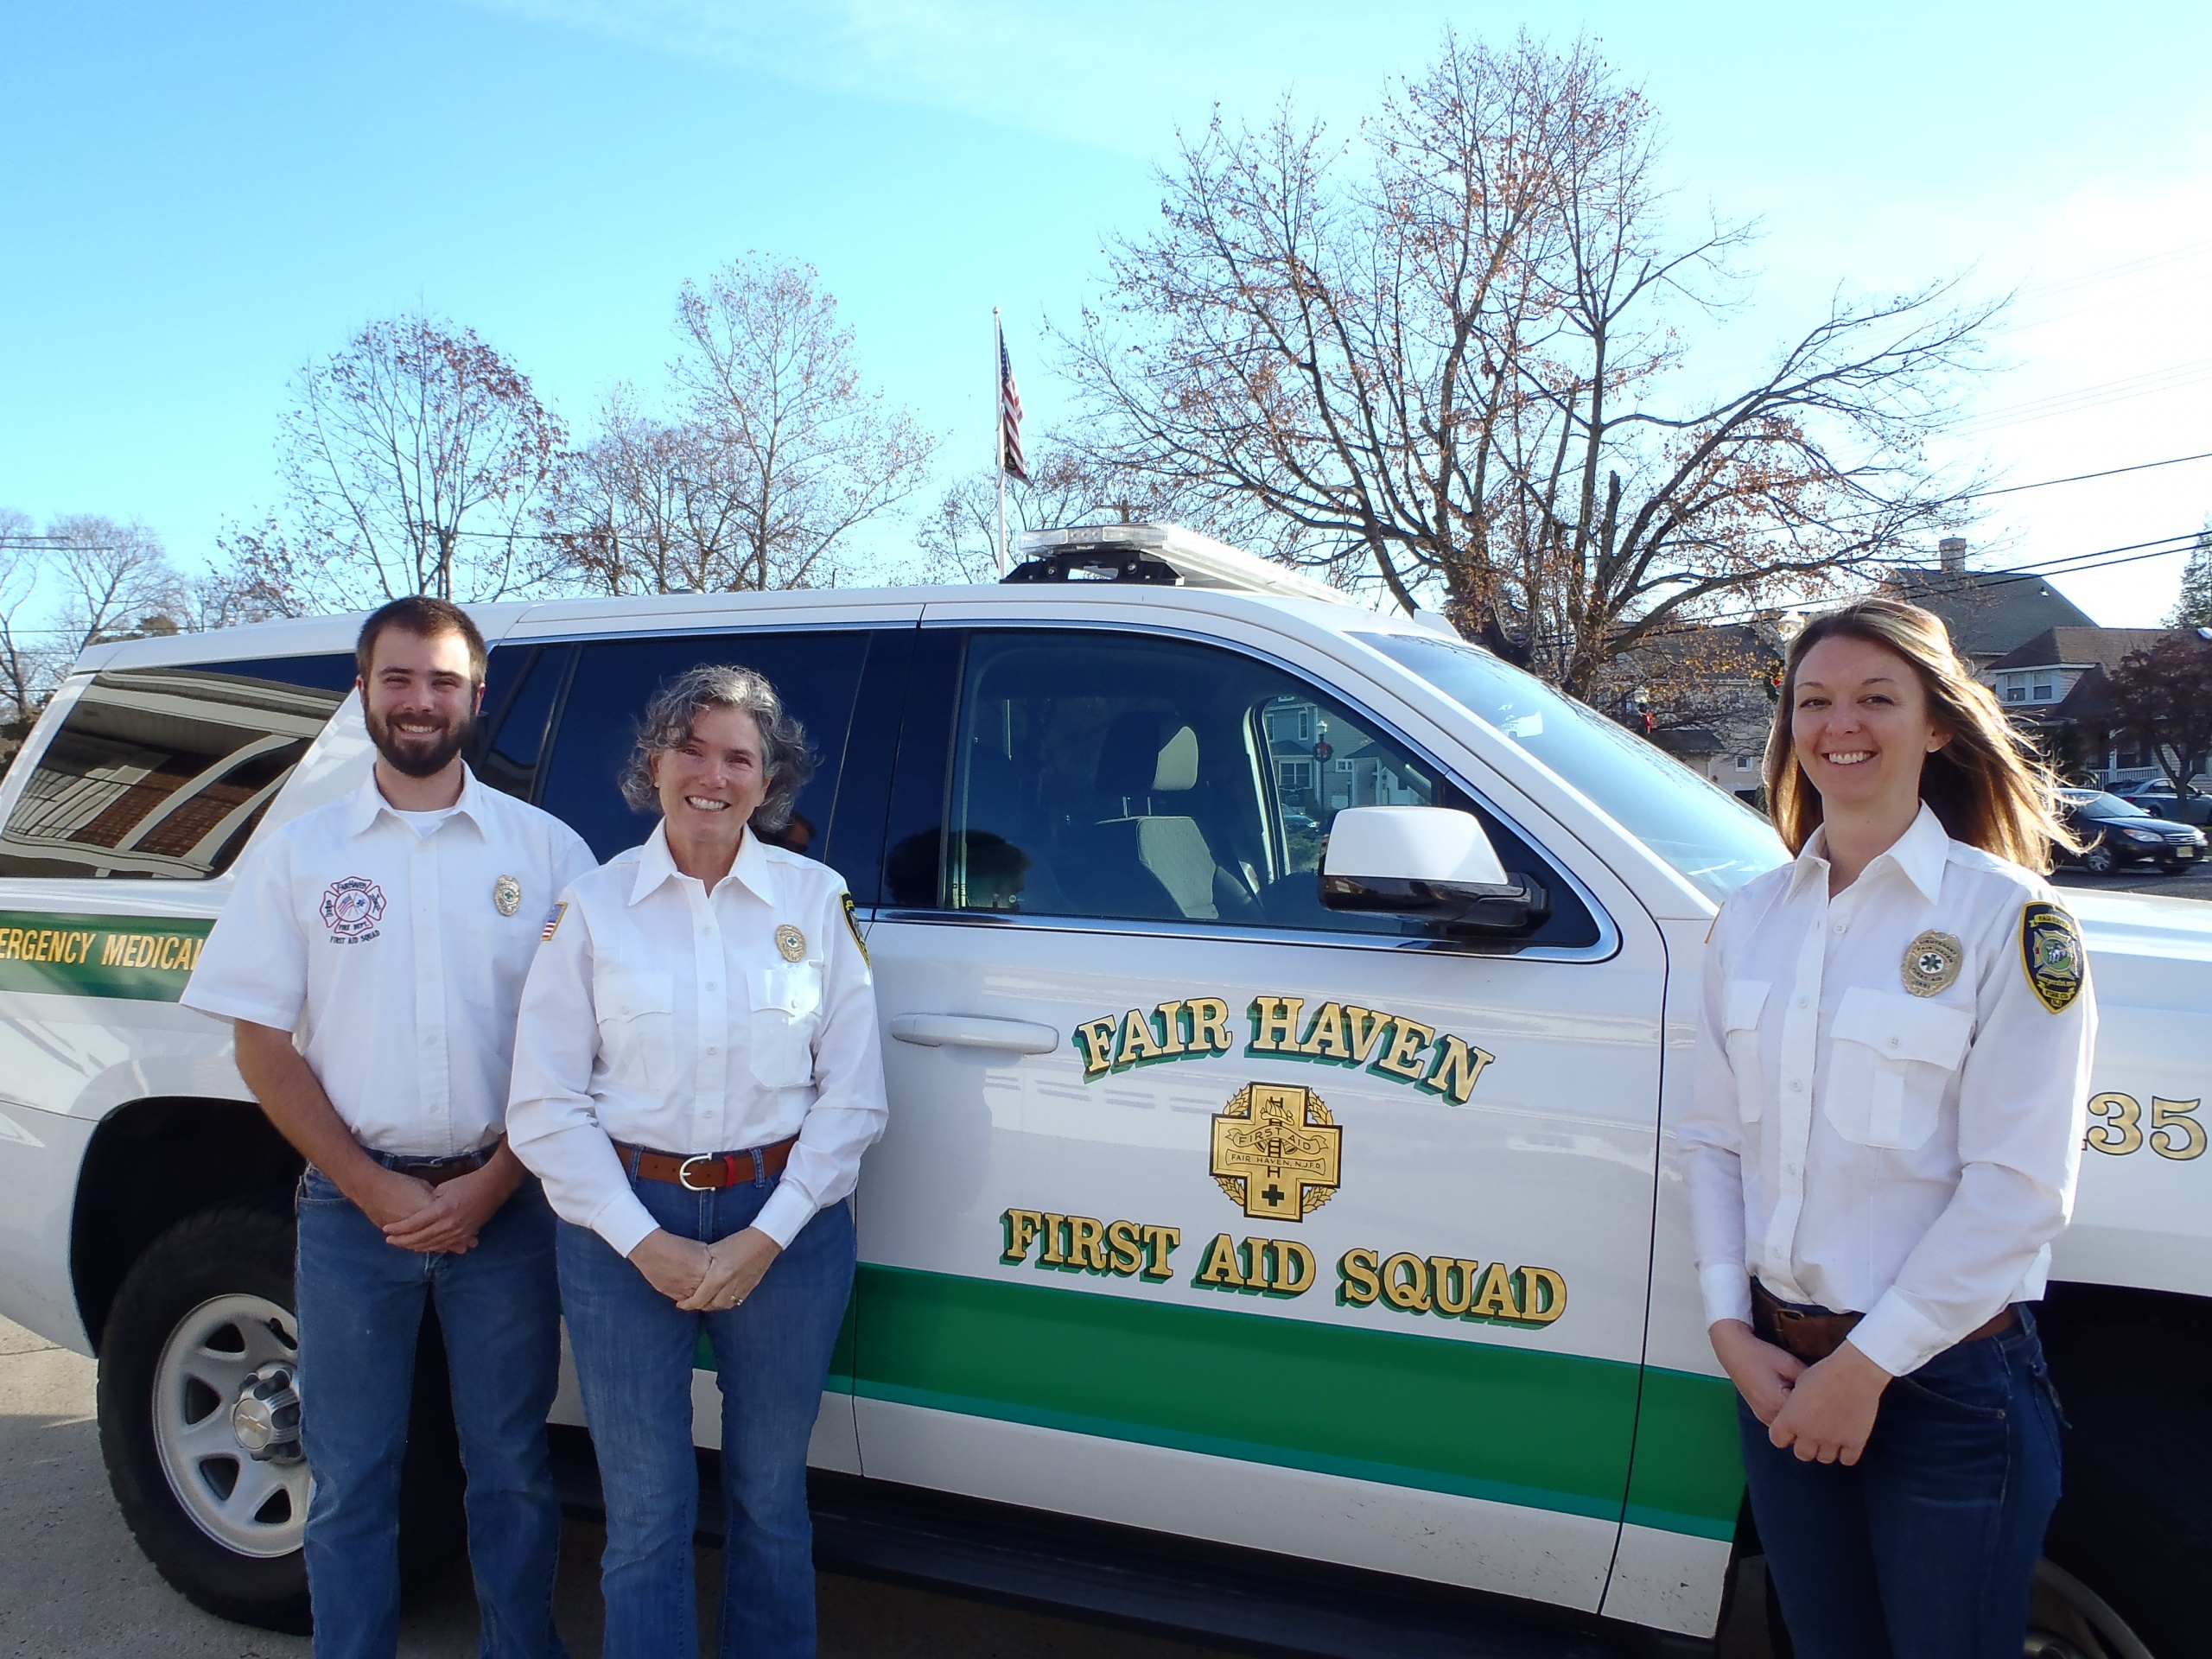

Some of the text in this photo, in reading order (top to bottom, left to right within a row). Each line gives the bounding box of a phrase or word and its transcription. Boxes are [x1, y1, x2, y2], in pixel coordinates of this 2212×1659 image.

[330, 936, 346, 944] FIRST
[360, 929, 380, 942] SQUAD
[1936, 948, 1953, 963] HAVEN
[1912, 967, 1928, 980] FIRST
[1072, 995, 1496, 1108] FAIR HAVEN
[2082, 1091, 2208, 1160] 35
[1239, 1127, 1311, 1151] FIRST AID
[1231, 1154, 1251, 1162] FAIR
[1256, 1155, 1293, 1167] HAVEN,
[1000, 1208, 1567, 1331] FIRST AID SQUAD
